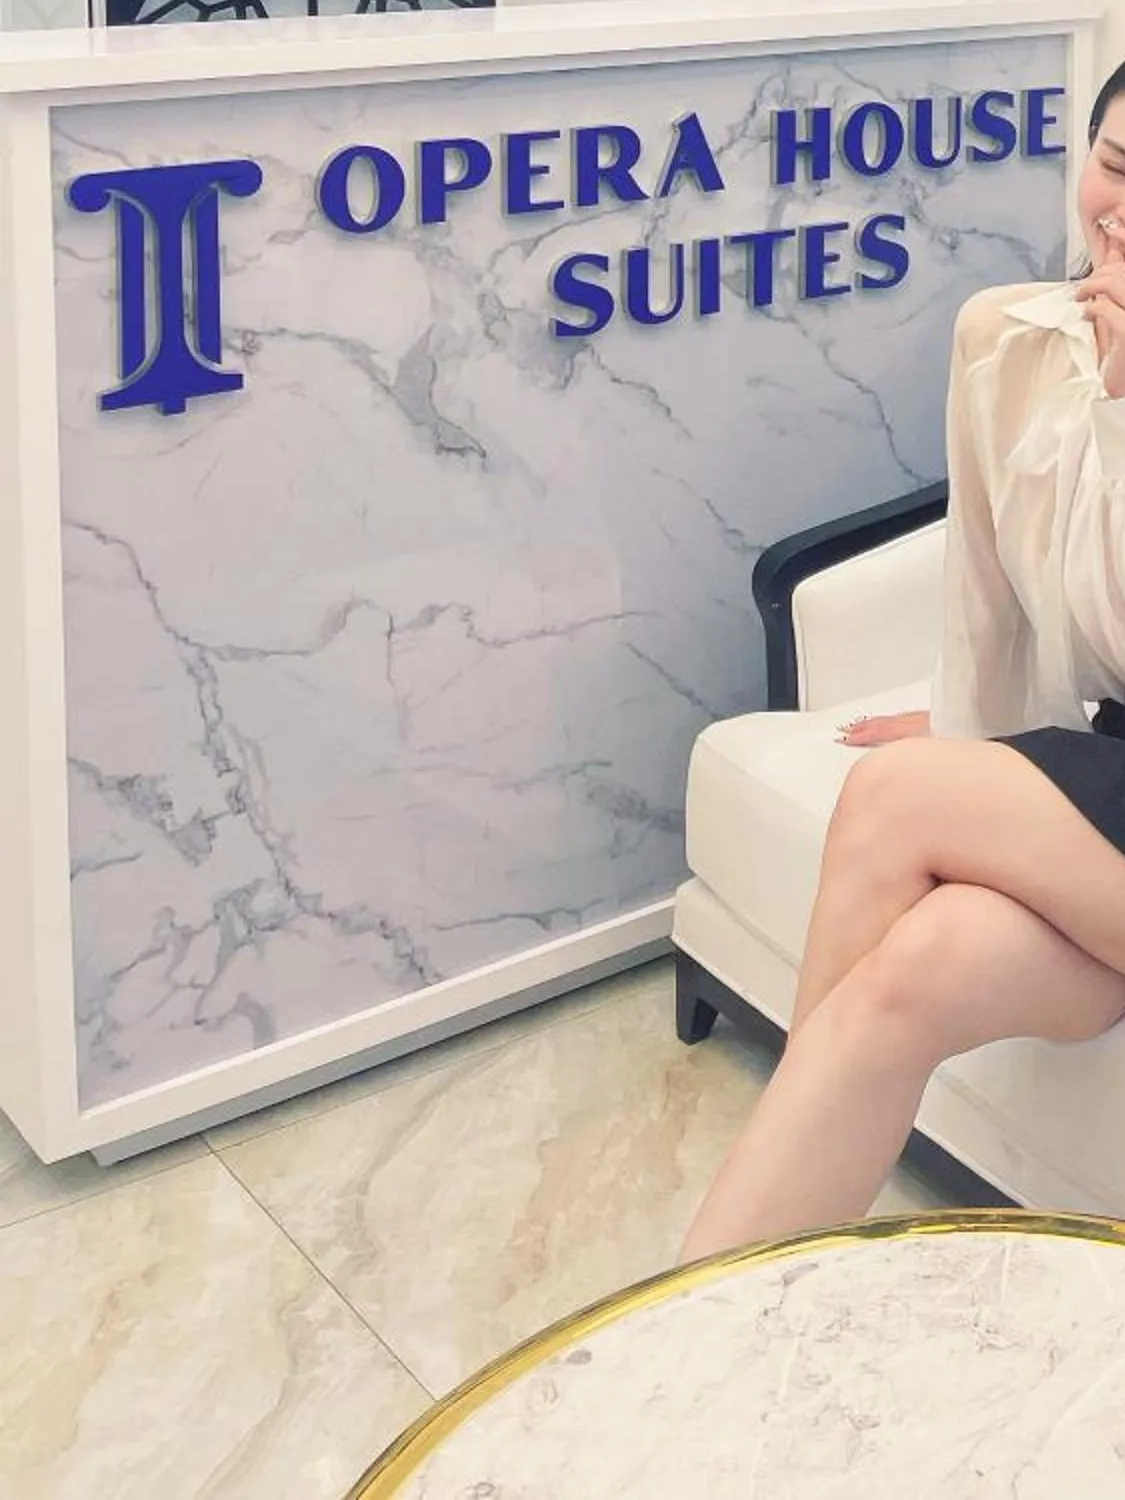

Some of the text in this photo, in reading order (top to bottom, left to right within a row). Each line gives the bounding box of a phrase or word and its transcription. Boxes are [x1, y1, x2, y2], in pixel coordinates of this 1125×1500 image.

[318, 86, 1068, 235] OPERA HOUSE
[551, 213, 912, 339] SUITES
